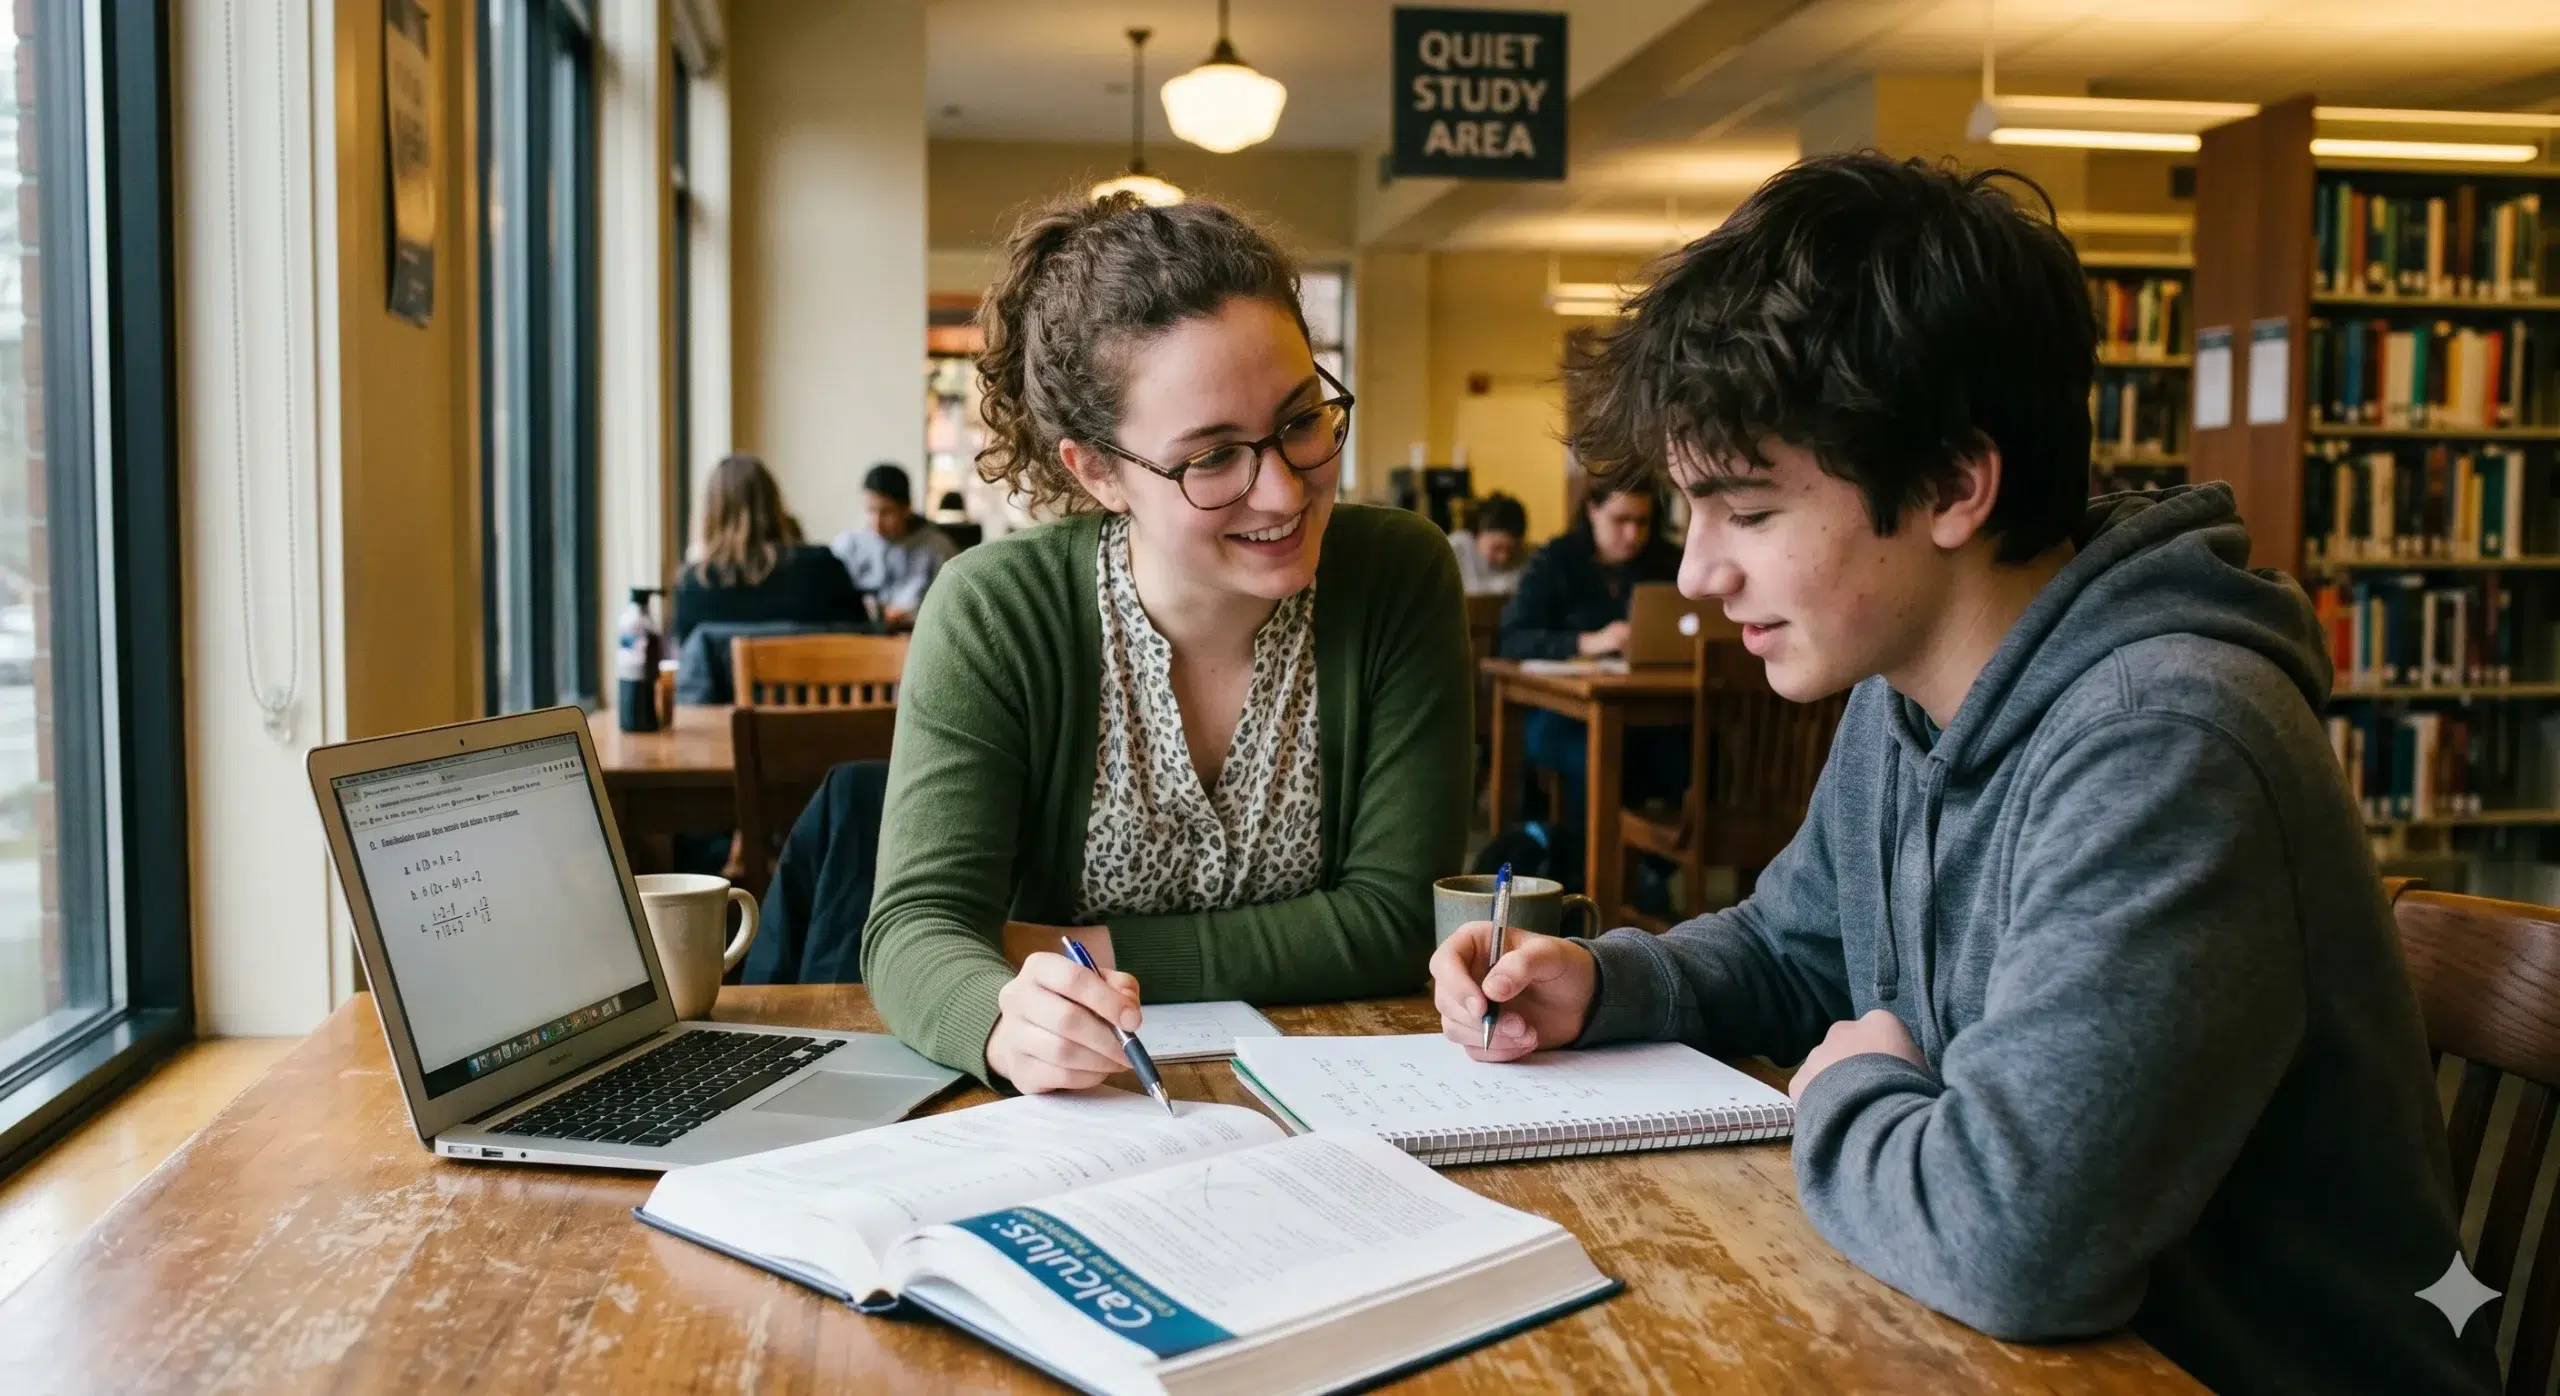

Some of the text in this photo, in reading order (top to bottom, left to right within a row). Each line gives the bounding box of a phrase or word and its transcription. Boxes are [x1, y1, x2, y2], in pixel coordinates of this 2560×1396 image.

[1418, 30, 1542, 70] QUIET
[1413, 75, 1548, 114] STUDY
[1423, 119, 1536, 158] AREA
[991, 1218, 1152, 1329] Calculus:
